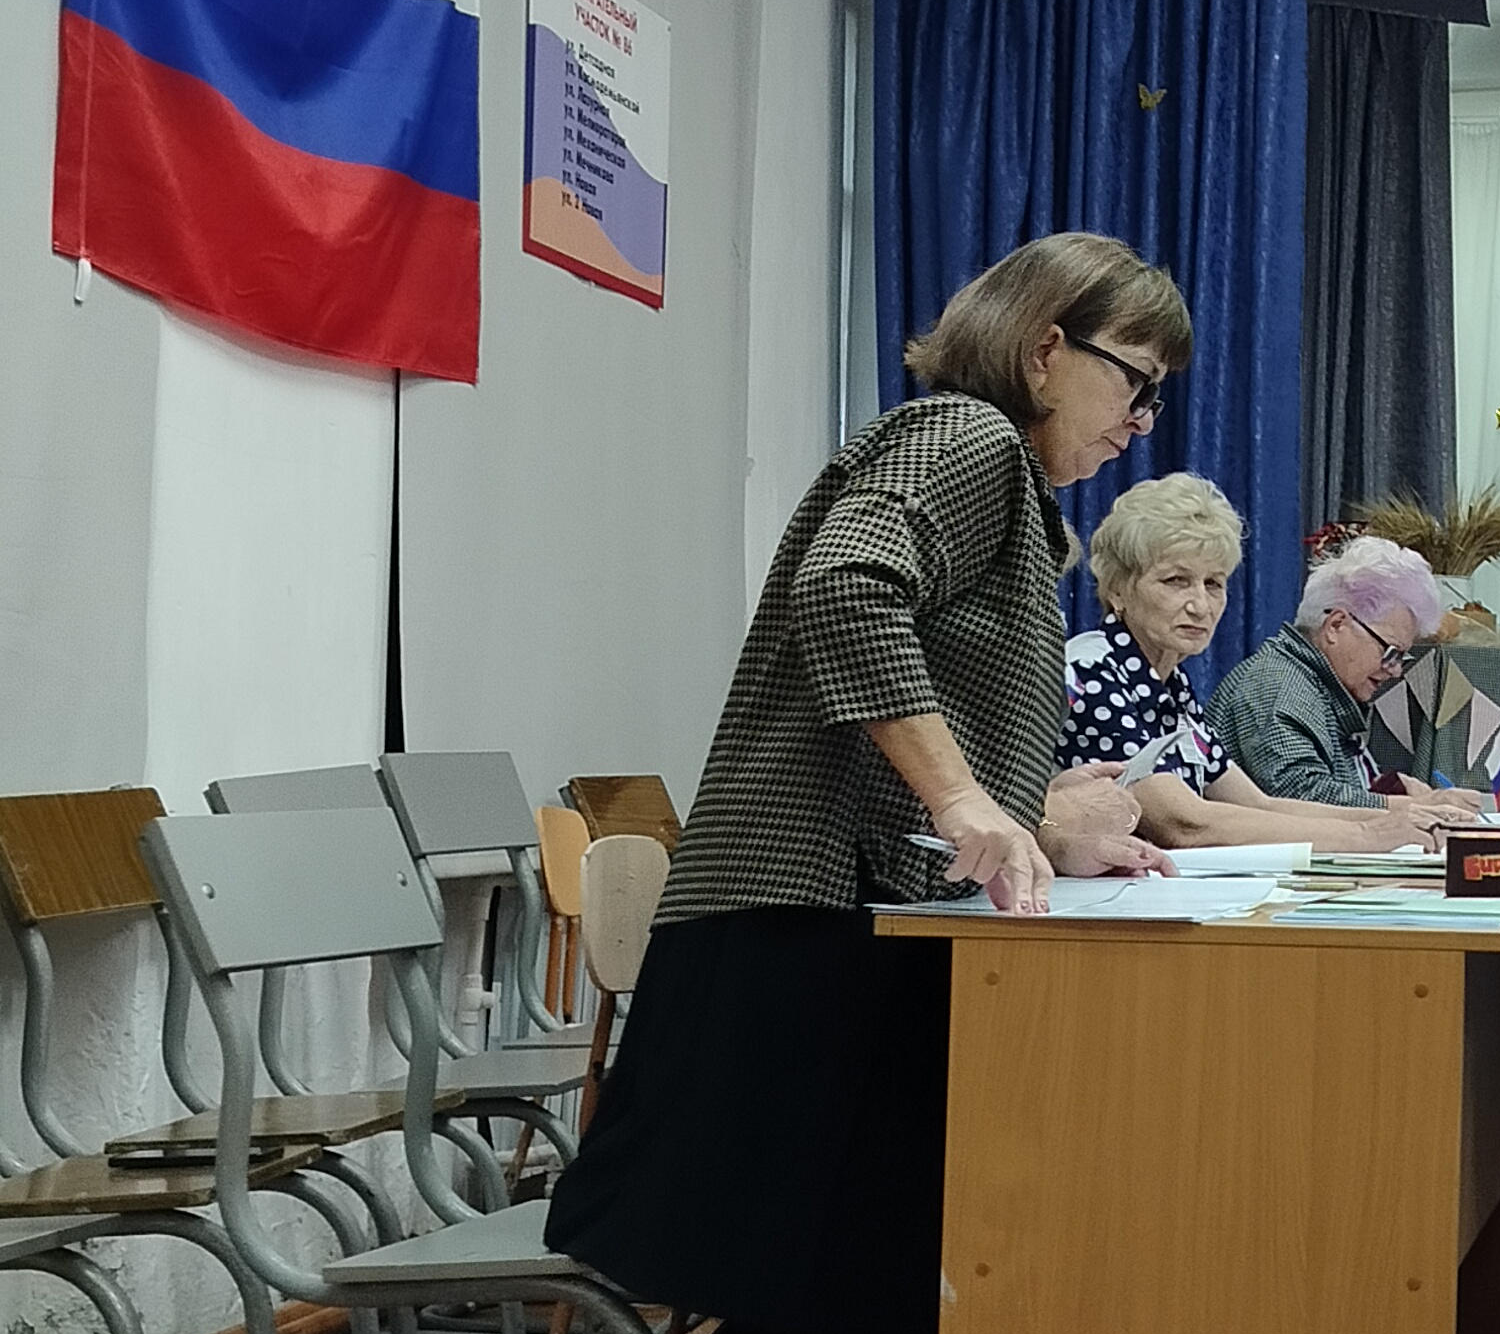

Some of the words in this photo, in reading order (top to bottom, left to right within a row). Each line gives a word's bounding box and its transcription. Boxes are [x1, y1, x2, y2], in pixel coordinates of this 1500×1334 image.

[575, 2, 610, 44] УЧАСТОК
[612, 28, 622, 50] №
[623, 35, 632, 56] 86
